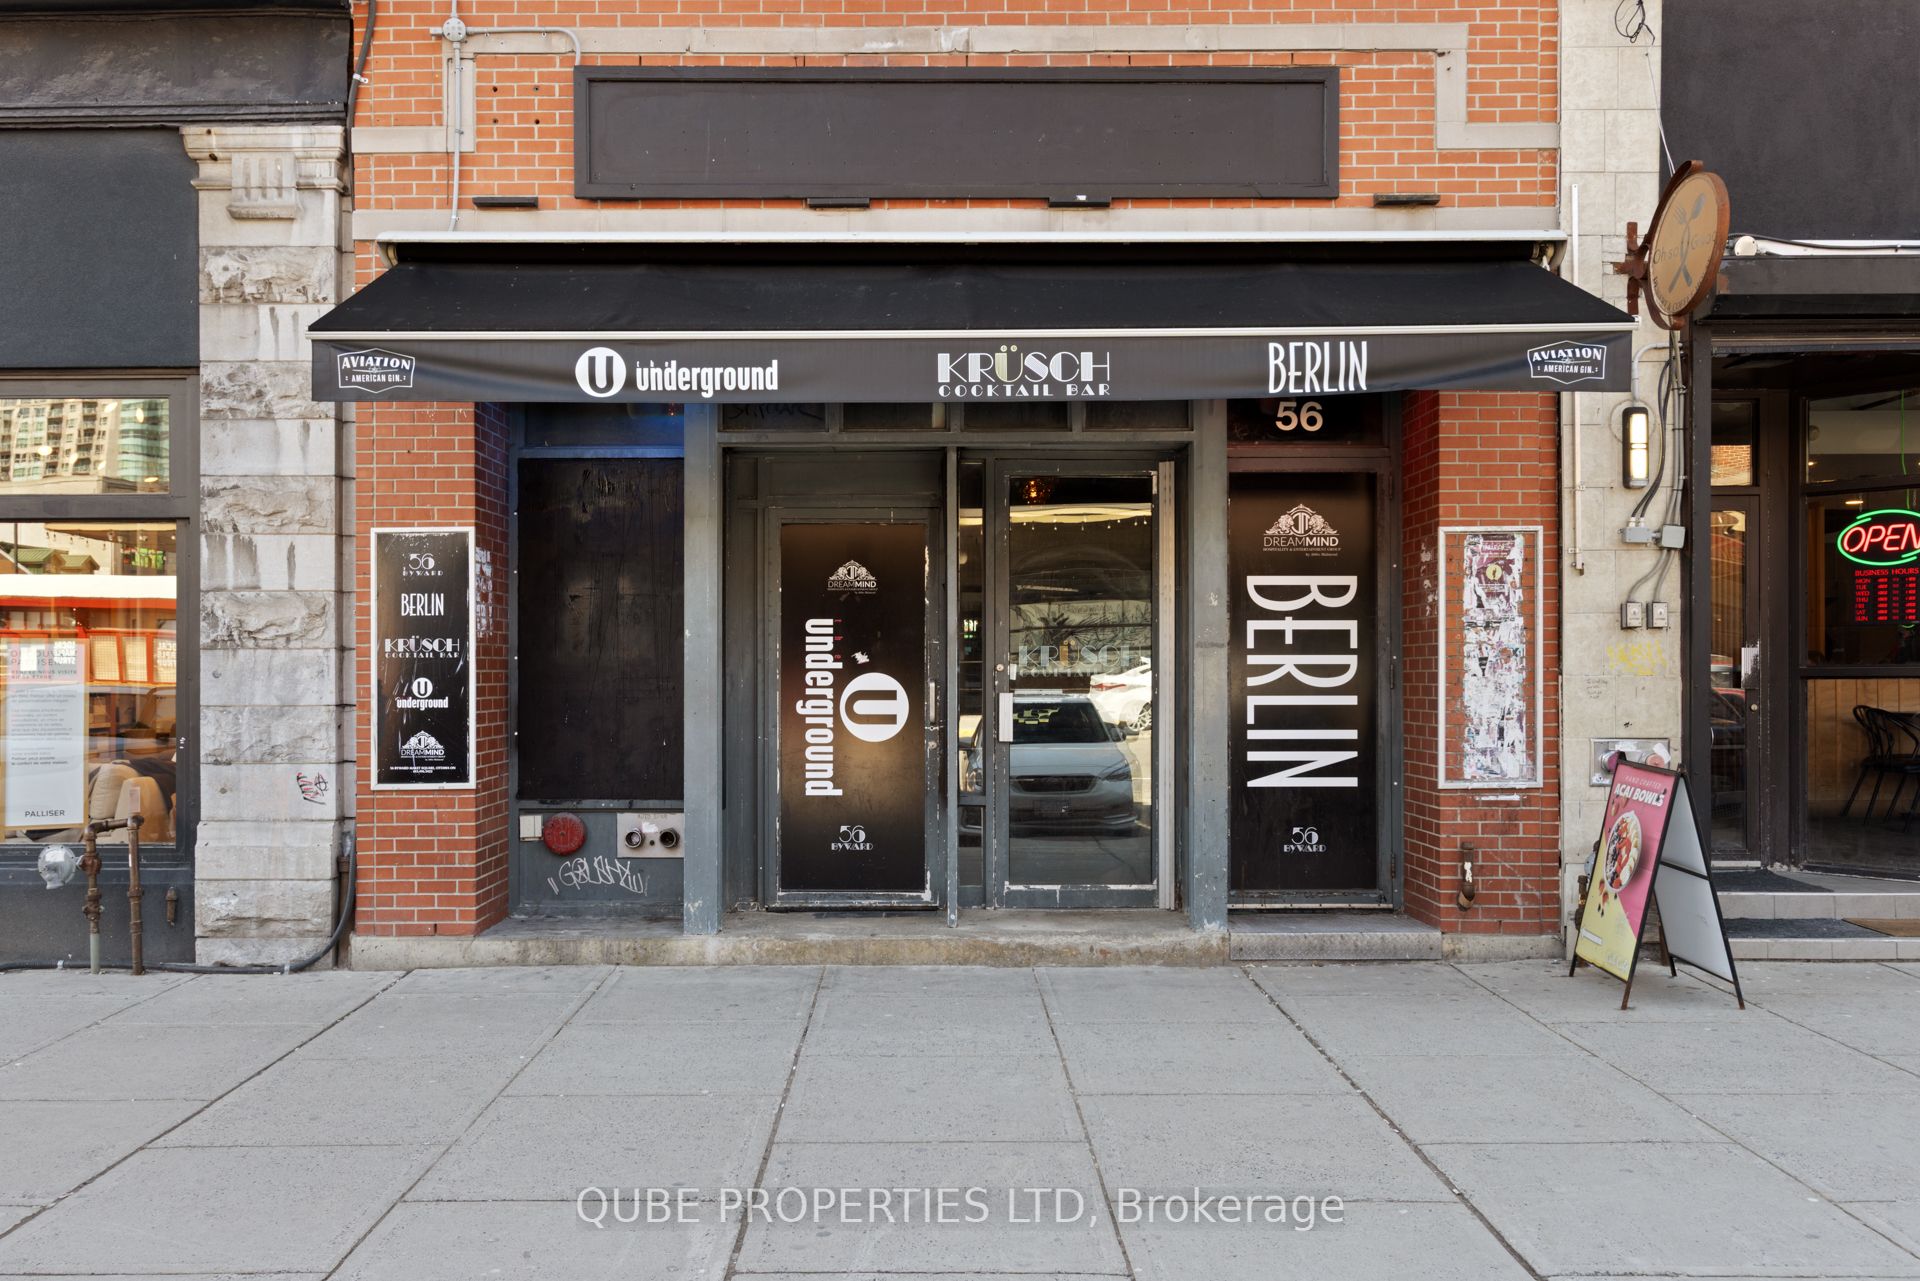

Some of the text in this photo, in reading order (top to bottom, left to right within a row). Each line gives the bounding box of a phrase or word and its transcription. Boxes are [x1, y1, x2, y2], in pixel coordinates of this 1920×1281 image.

[1532, 347, 1602, 362] AVIATION
[342, 356, 411, 371] AVIATION
[937, 344, 1110, 383] KRÜSCH
[1268, 341, 1367, 393] BERLIN
[1543, 364, 1578, 373] AMERICAN
[352, 374, 386, 383] AMERICAN
[636, 359, 778, 399] underground
[938, 383, 1110, 398] COCKTAIL BAR
[1275, 401, 1323, 432] 56
[1263, 536, 1339, 547] DREAMMIND
[1843, 523, 1920, 552] OPEN
[409, 553, 435, 570] 56
[1855, 567, 1919, 577] BUSINESS HOURS
[827, 580, 877, 588] DREAMMIND
[401, 593, 444, 617] BERLIN
[384, 635, 460, 653] KRÜSCH
[1018, 639, 1142, 668] KRÜSCH
[1246, 575, 1358, 788] BERLIN
[396, 696, 449, 711] underground
[796, 618, 843, 796] underground
[1632, 788, 1665, 807] BOWLS
[25, 809, 65, 817] PALLISER
[839, 825, 866, 843] 56
[1291, 826, 1319, 845] 56
[831, 842, 873, 852] BYWARD
[1283, 844, 1327, 854] BYWARD
